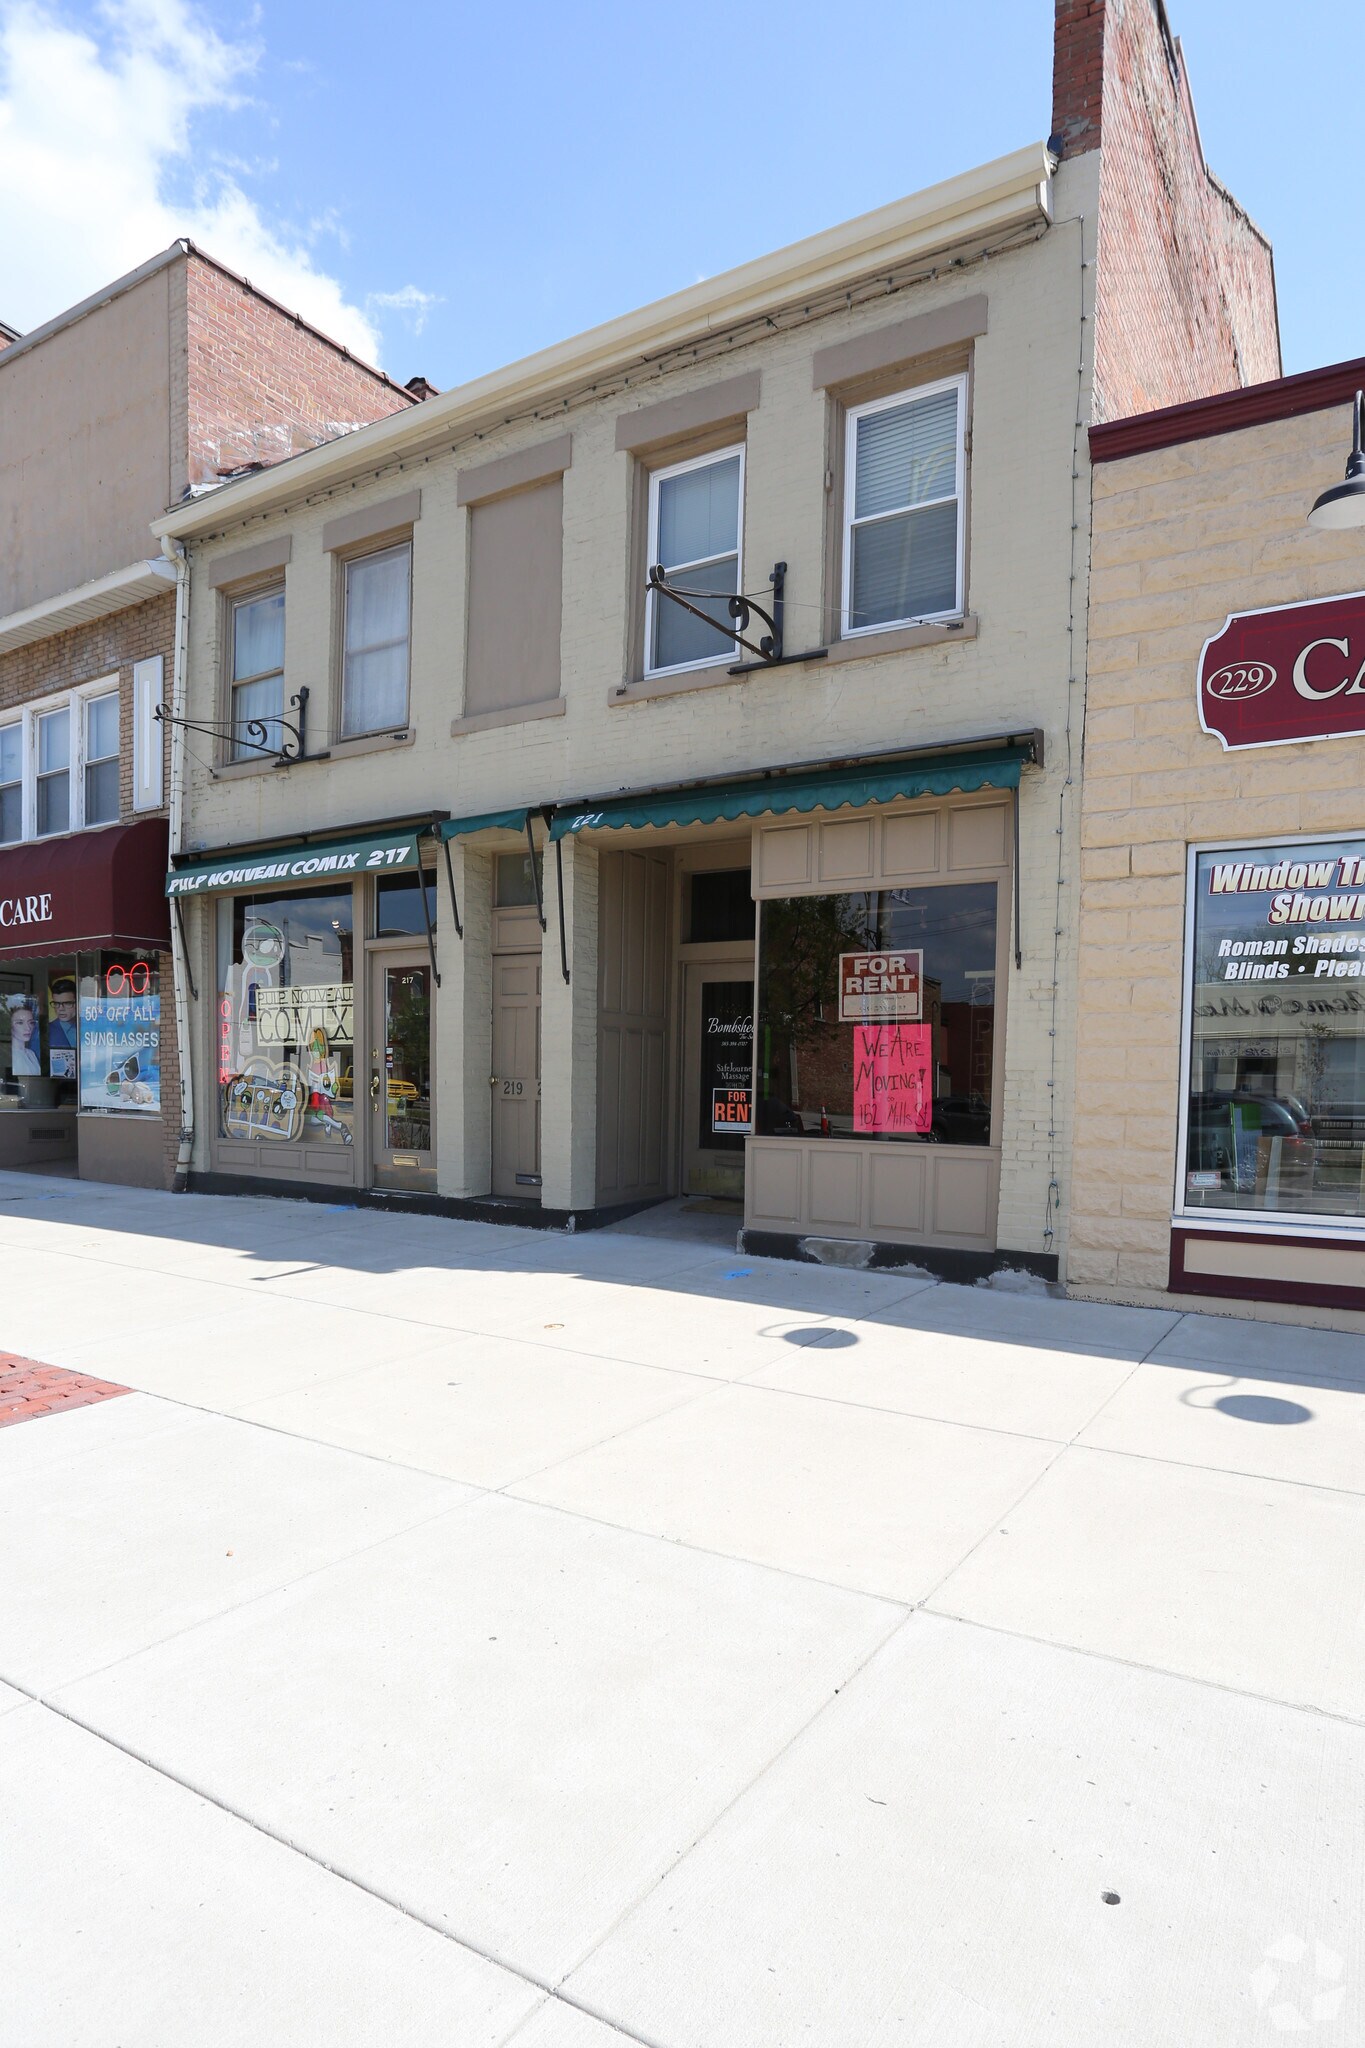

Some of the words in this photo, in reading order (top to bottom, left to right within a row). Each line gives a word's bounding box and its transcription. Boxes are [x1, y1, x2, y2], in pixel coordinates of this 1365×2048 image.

[1219, 667, 1264, 695] 229
[571, 813, 604, 829] 221
[168, 874, 207, 893] PULP
[208, 862, 291, 887] NOUVEAU
[291, 852, 360, 875] COMIX
[366, 846, 411, 866] 217
[1209, 859, 1337, 896] Window
[0, 893, 53, 927] CARE
[1218, 939, 1289, 957] Roman
[853, 957, 907, 975] FOR
[1224, 960, 1290, 980] Blinds
[402, 976, 414, 984] 217
[845, 974, 916, 994] RENT
[258, 989, 287, 1005] PULP
[291, 985, 353, 1003] NOUVEAU
[85, 1006, 103, 1021] 50%
[106, 1007, 131, 1022] OFF
[134, 1005, 156, 1021] ALL
[259, 1005, 351, 1043] COMIX
[84, 1031, 159, 1048] SUNGLASSES
[220, 999, 232, 1084] OPEN
[721, 1072, 750, 1082] Massage
[503, 1081, 523, 1095] 219
[728, 1091, 747, 1102] FOR
[859, 1103, 882, 1127] 162
